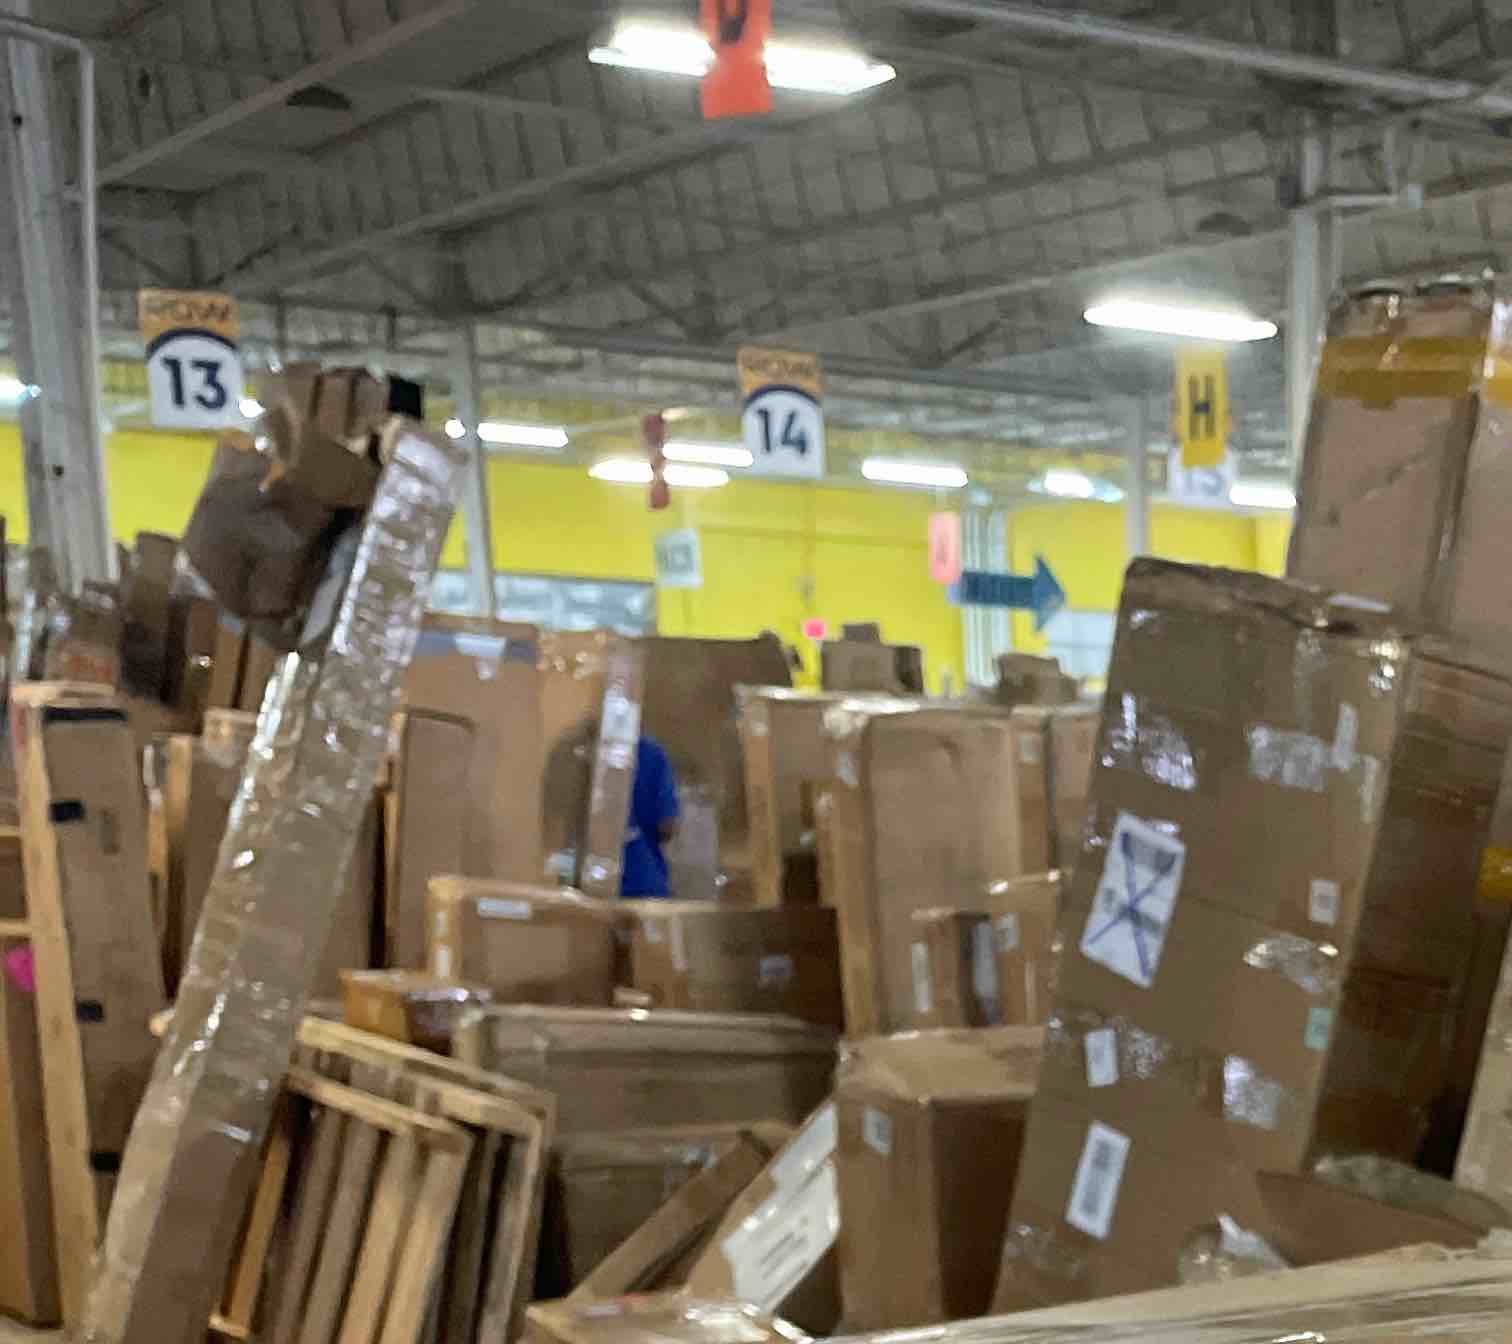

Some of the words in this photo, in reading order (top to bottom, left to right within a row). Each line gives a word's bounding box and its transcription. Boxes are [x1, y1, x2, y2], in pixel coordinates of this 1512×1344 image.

[162, 356, 228, 411] 13
[1188, 374, 1216, 439] H
[756, 407, 808, 455] 14
